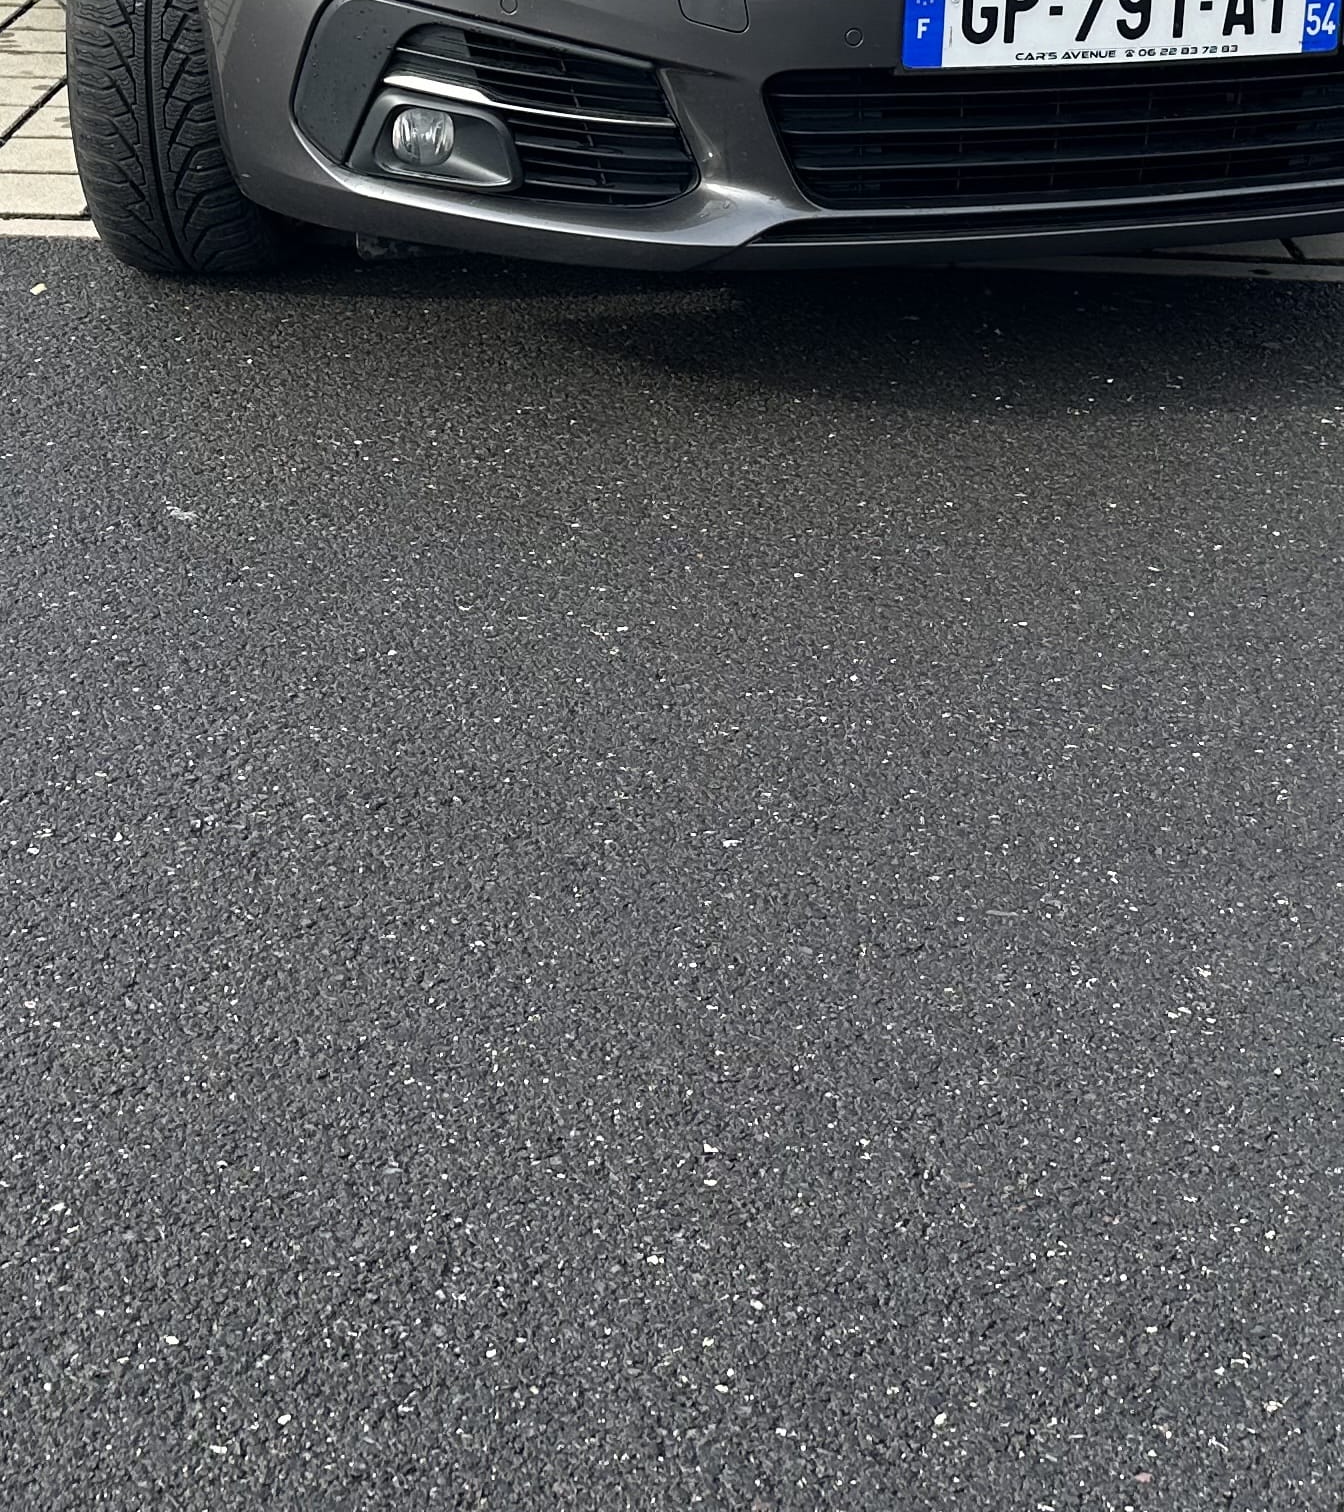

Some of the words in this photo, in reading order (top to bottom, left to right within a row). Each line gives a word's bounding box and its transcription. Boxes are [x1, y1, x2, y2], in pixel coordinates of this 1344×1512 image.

[916, 18, 930, 39] F
[1306, 2, 1336, 36] 54
[1015, 51, 1057, 61] CAR'S
[1061, 50, 1116, 60] AVENUE
[1138, 48, 1156, 57] 06
[1160, 47, 1177, 56] 22
[1202, 45, 1218, 54] 72
